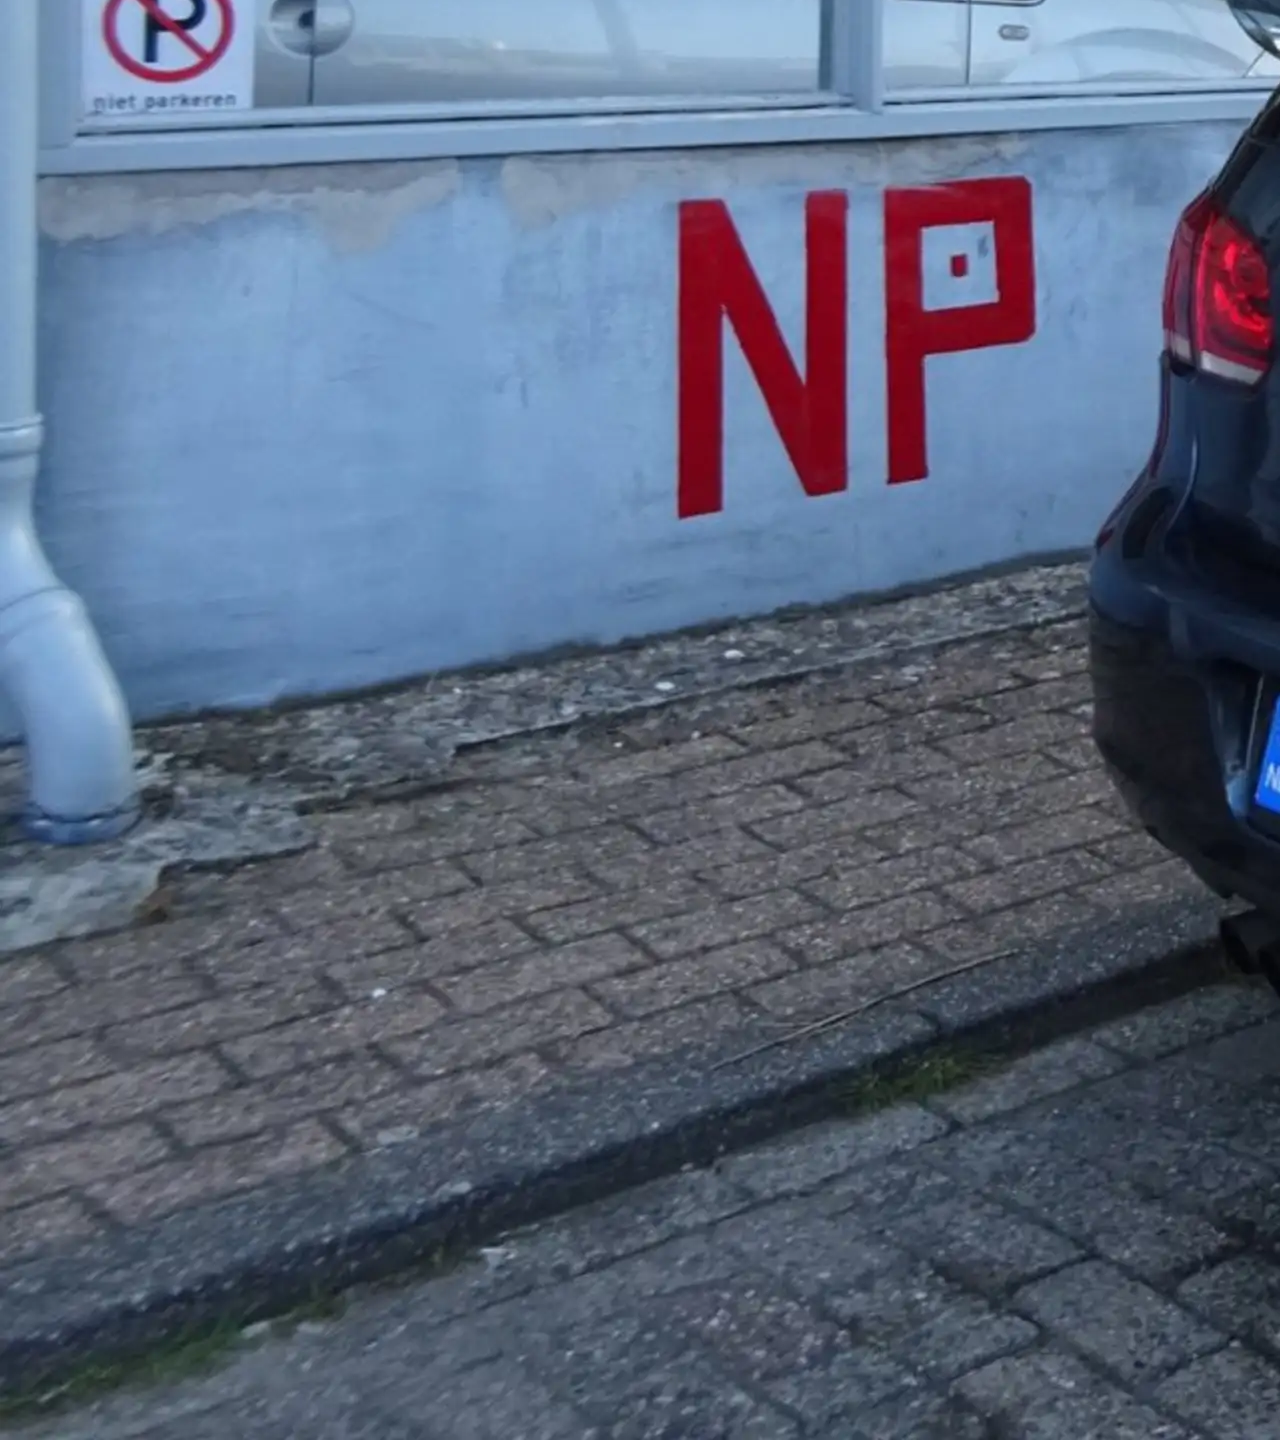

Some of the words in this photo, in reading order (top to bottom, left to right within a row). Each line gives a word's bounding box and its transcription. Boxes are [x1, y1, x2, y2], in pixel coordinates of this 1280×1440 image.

[93, 94, 136, 111] niet
[144, 93, 237, 110] parkeren
[677, 176, 1037, 520] NP
